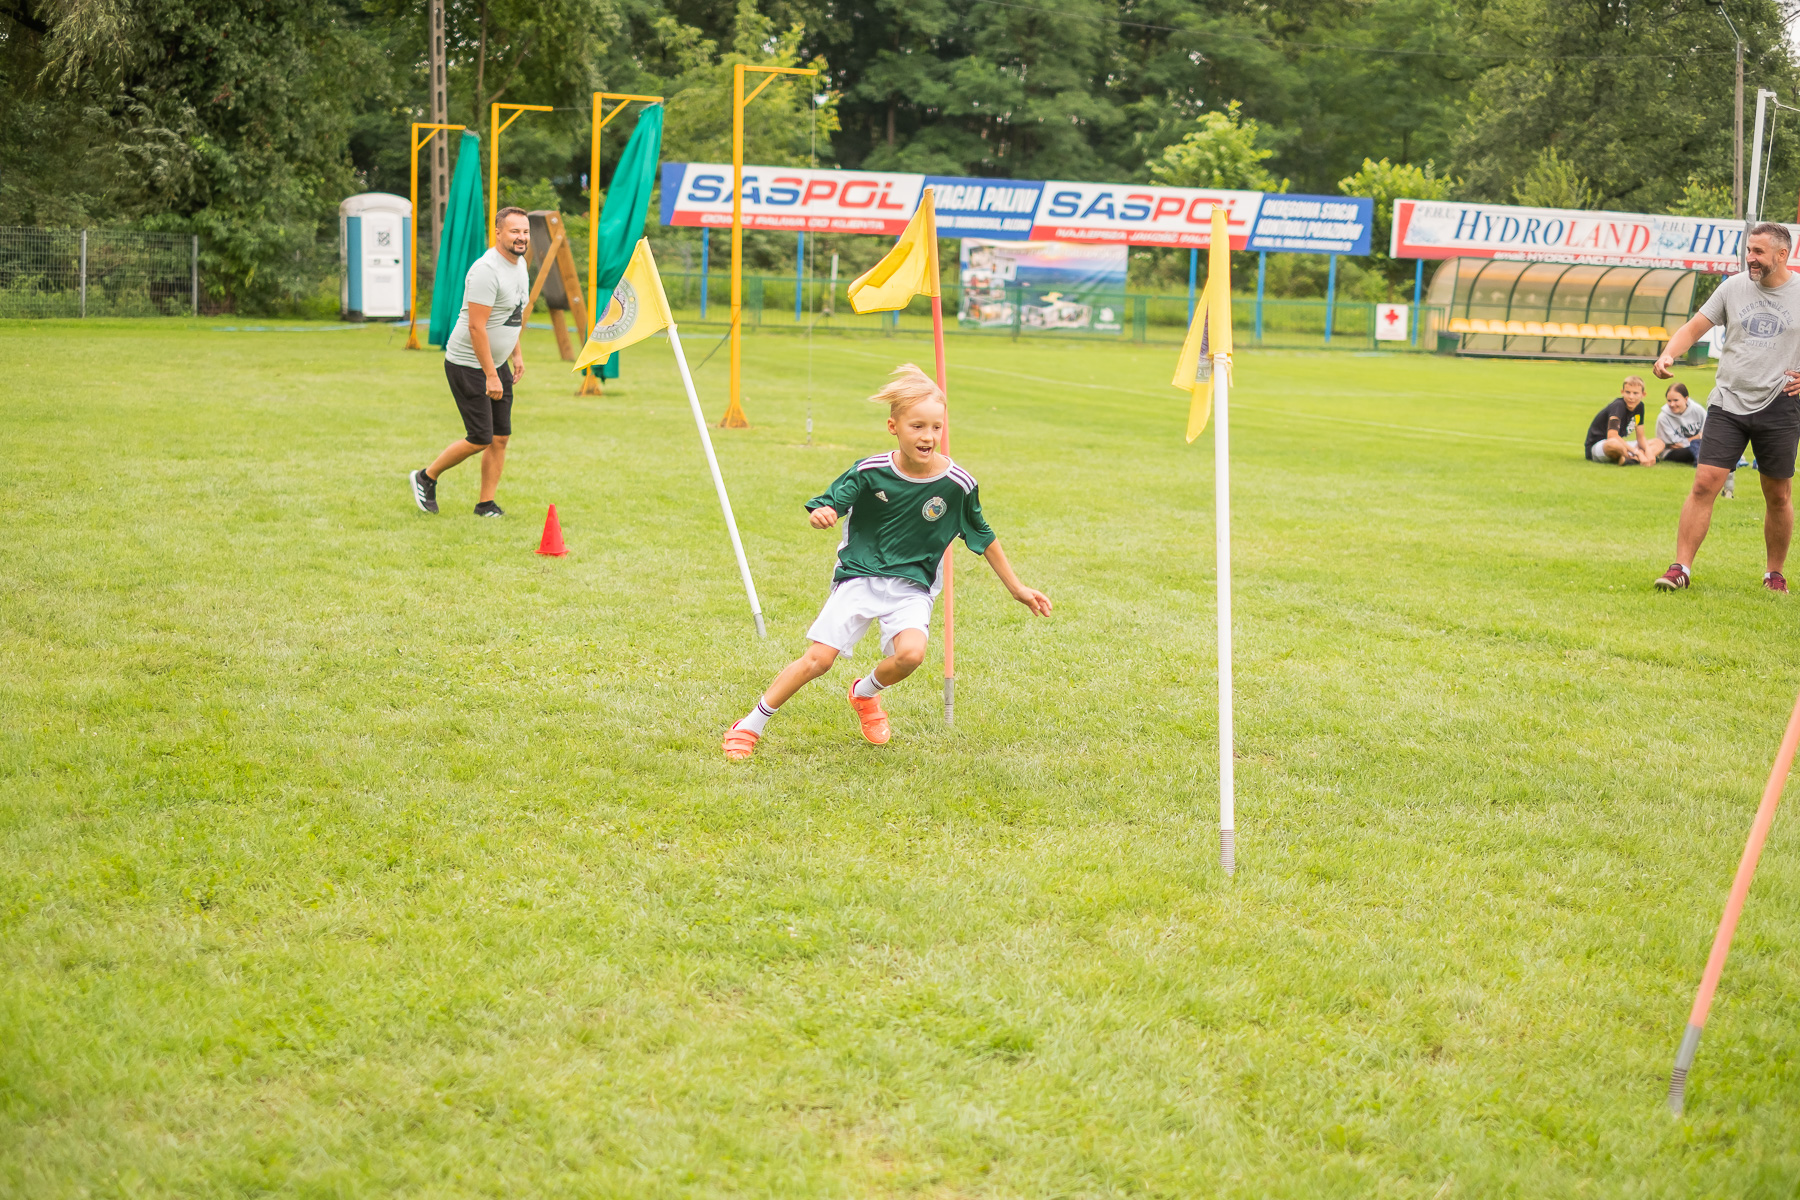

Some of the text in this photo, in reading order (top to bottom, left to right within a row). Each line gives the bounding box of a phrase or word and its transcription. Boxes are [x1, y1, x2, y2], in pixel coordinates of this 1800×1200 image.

[687, 174, 905, 211] SASPOL
[1048, 190, 1247, 226] SASPOL
[1454, 209, 1651, 255] HYDROLAND
[1757, 320, 1773, 335] 64
